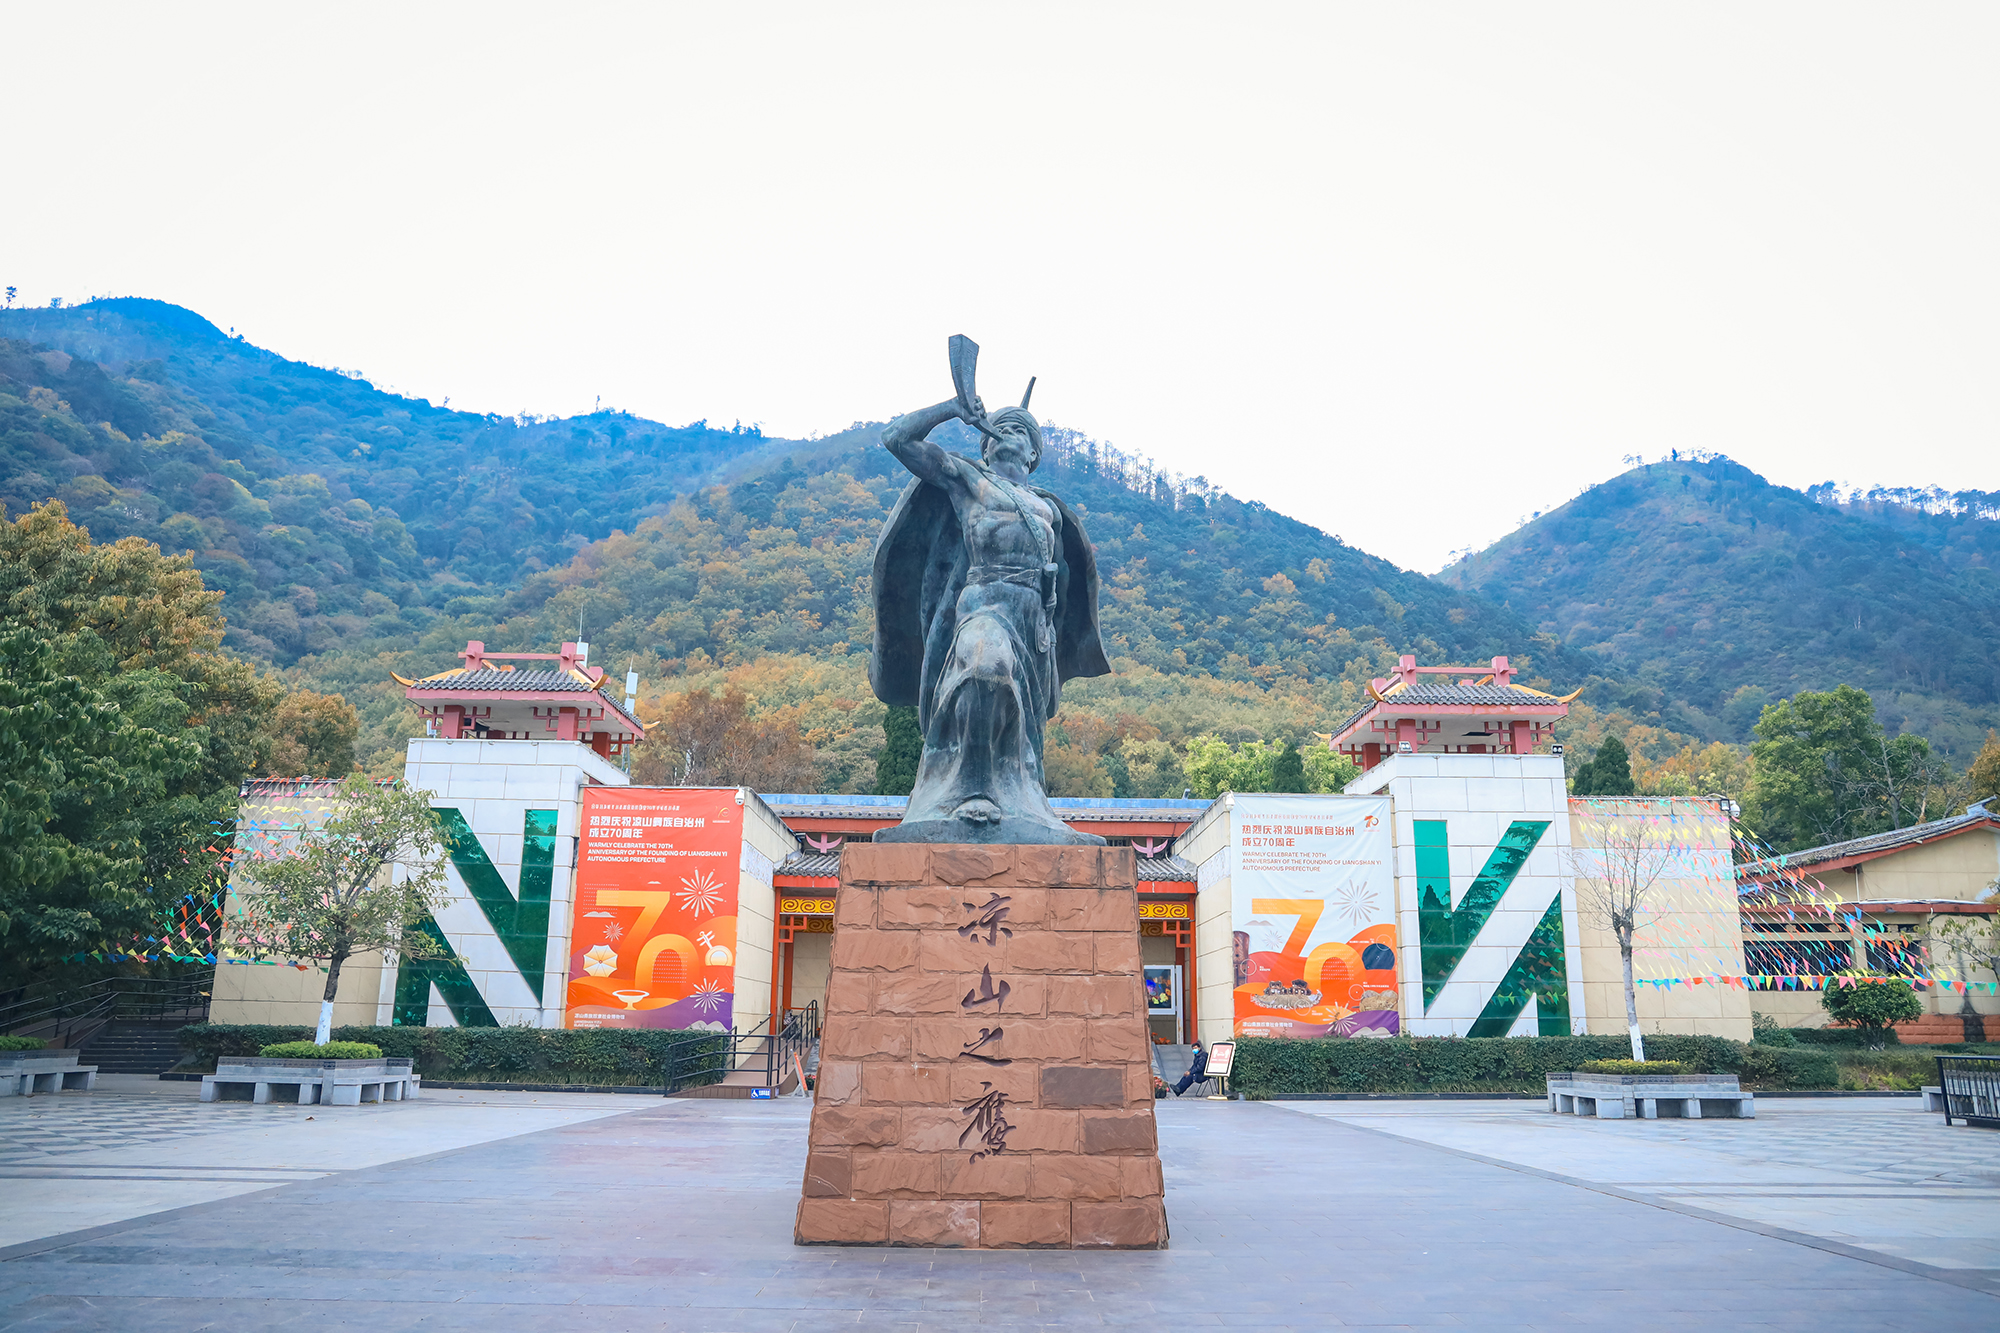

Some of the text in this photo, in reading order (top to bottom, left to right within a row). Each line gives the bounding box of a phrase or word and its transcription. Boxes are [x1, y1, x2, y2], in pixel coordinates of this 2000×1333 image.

[588, 828, 643, 838] 成立70周年
[1242, 837, 1295, 847] 成立70周年
[596, 890, 699, 996] 70
[1252, 898, 1366, 1000] 70
